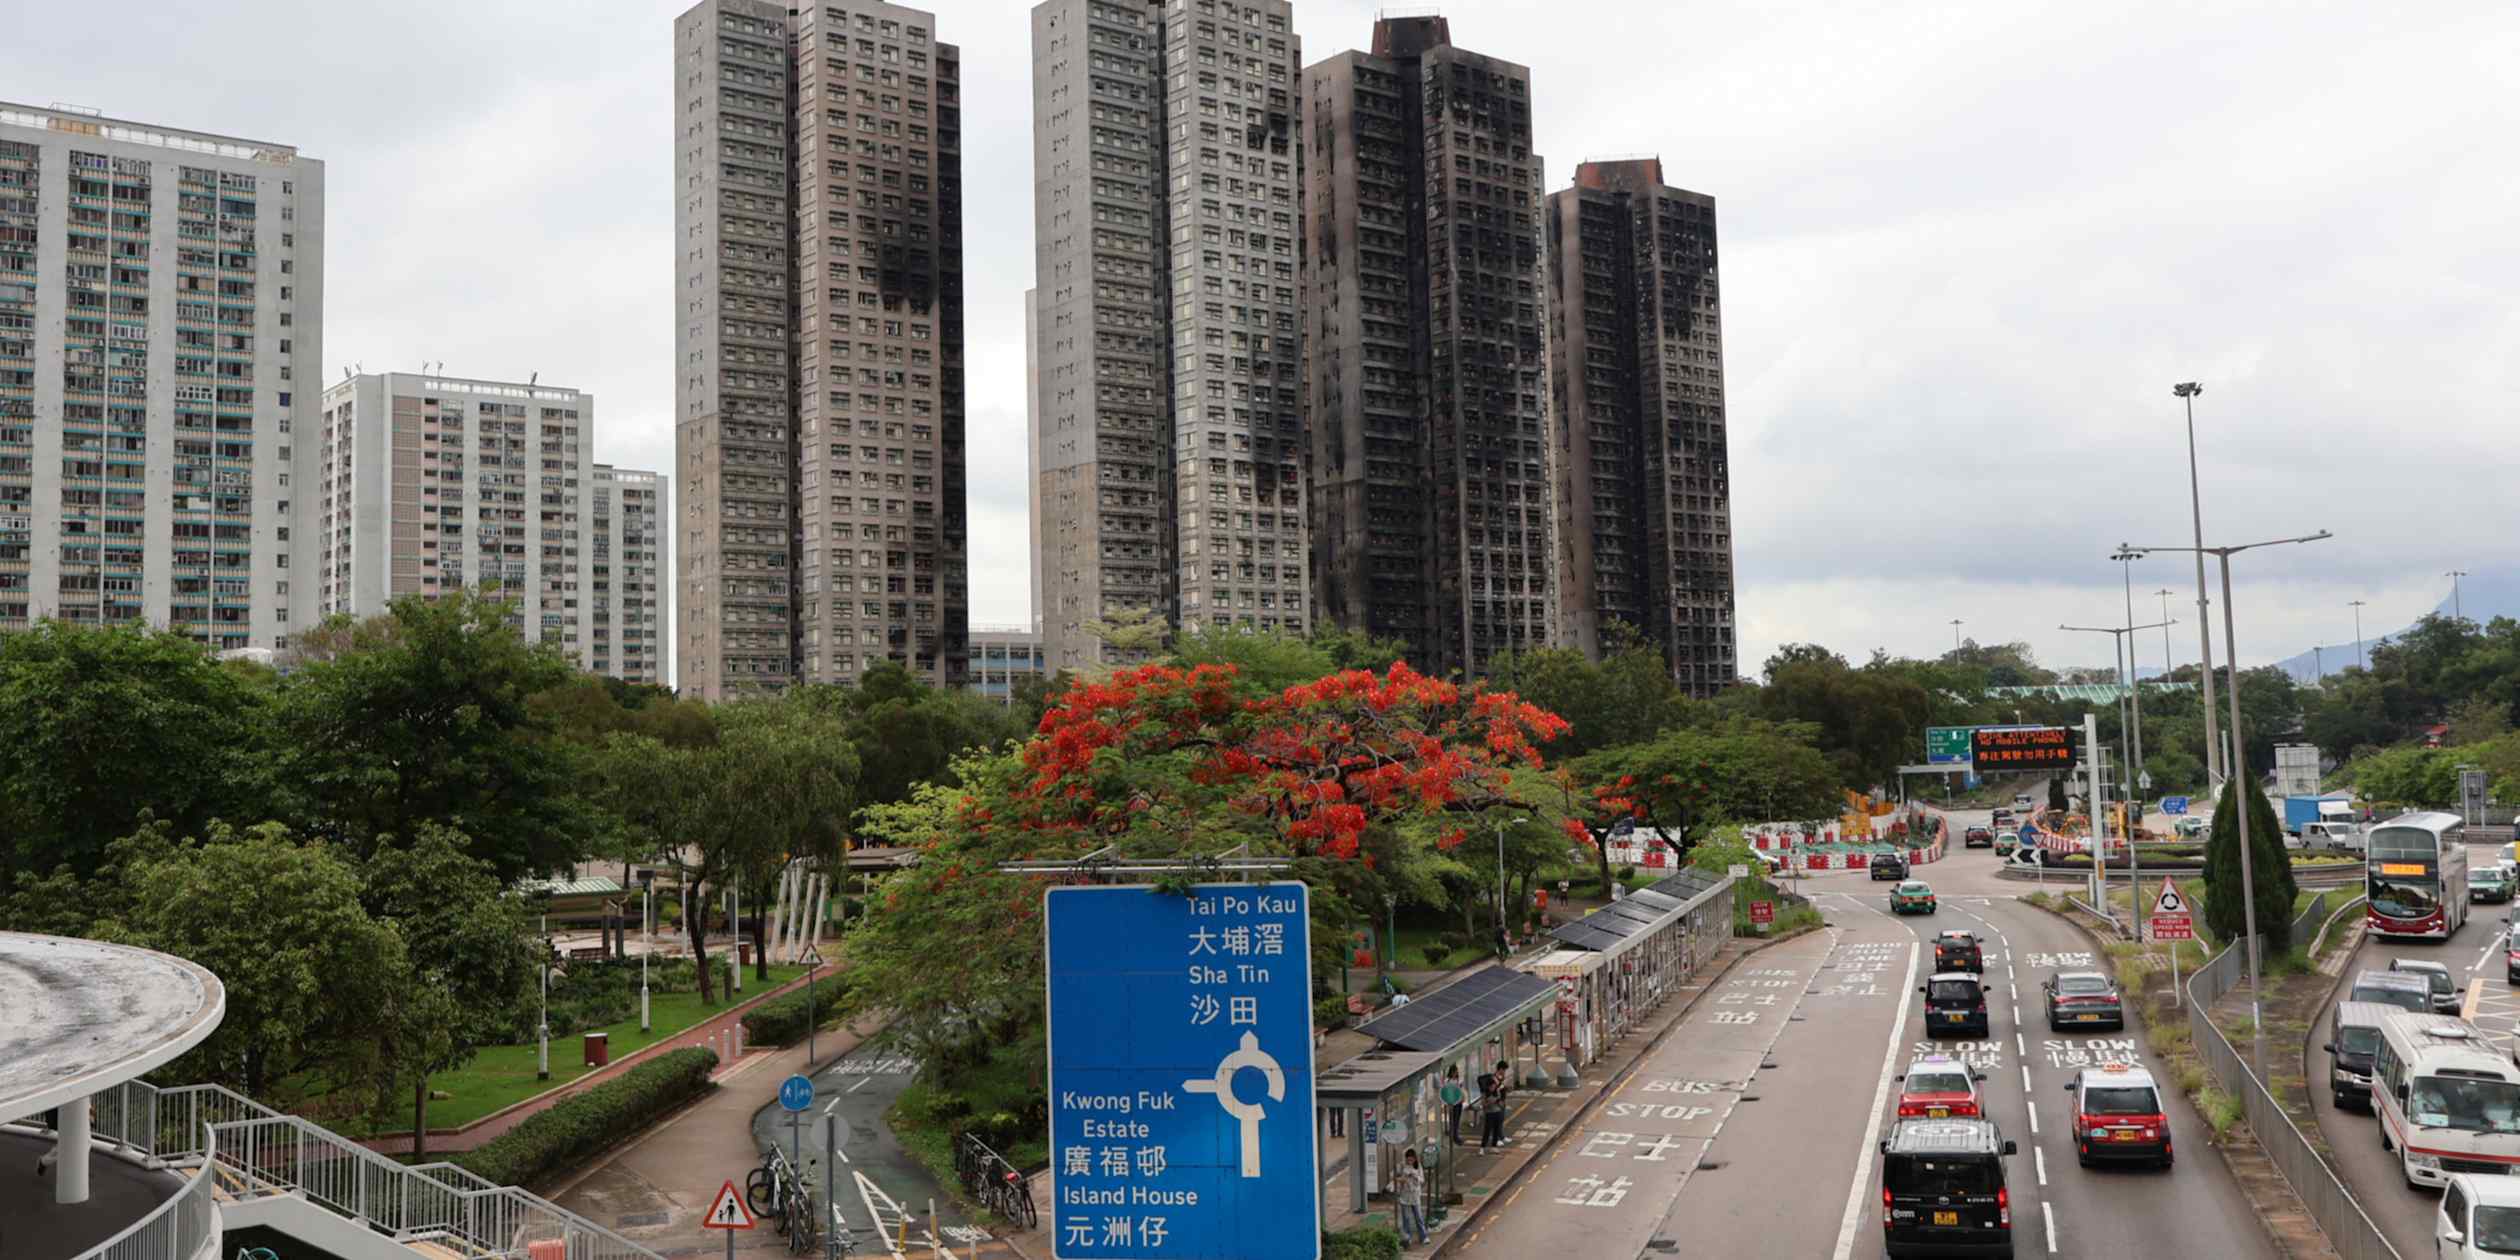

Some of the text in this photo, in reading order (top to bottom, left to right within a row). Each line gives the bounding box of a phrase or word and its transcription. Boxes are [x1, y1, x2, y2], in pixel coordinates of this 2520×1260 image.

[1188, 896, 1297, 915] Tai Po Kau
[1188, 923, 1284, 956] 大埔滘
[1189, 965, 1270, 984] Sha Tin
[1717, 993, 1780, 1006] 巴士
[1190, 995, 1258, 1025] 沙田
[1912, 1041, 2002, 1053] SLOW
[2043, 1038, 2136, 1050] SLOW
[1641, 1079, 1716, 1094] BUS
[1063, 1091, 1175, 1113] Kwong Fuk
[1606, 1103, 1713, 1120] STOP
[1083, 1119, 1150, 1138] Estate
[1577, 1131, 1681, 1161] 巴士
[1063, 1145, 1168, 1178] 廣福邨
[1064, 1186, 1199, 1206] Island House
[1554, 1173, 1633, 1207] 站
[1065, 1216, 1169, 1248] 元洲仔
